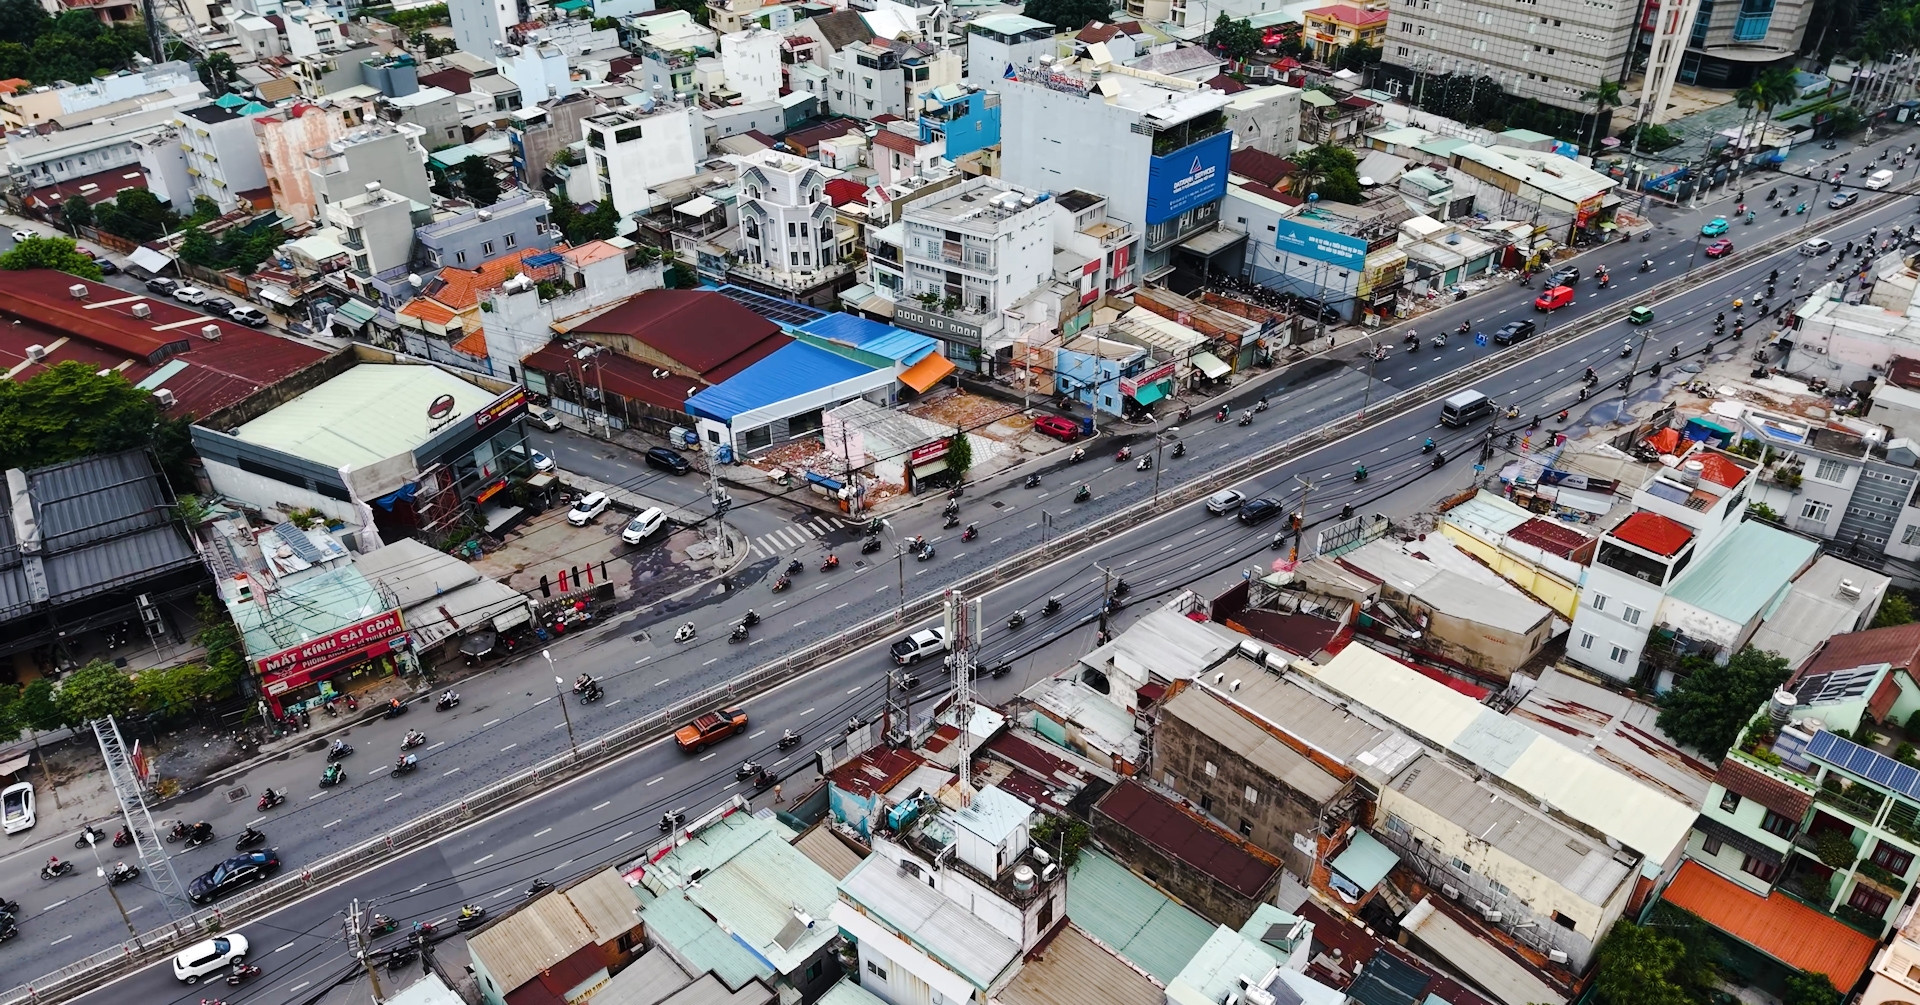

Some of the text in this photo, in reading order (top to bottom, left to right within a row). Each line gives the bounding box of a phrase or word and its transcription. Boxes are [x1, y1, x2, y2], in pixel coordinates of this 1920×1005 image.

[266, 618, 395, 672] MẮT KÍNH SÀI GÒN
[387, 625, 402, 636] CAO
